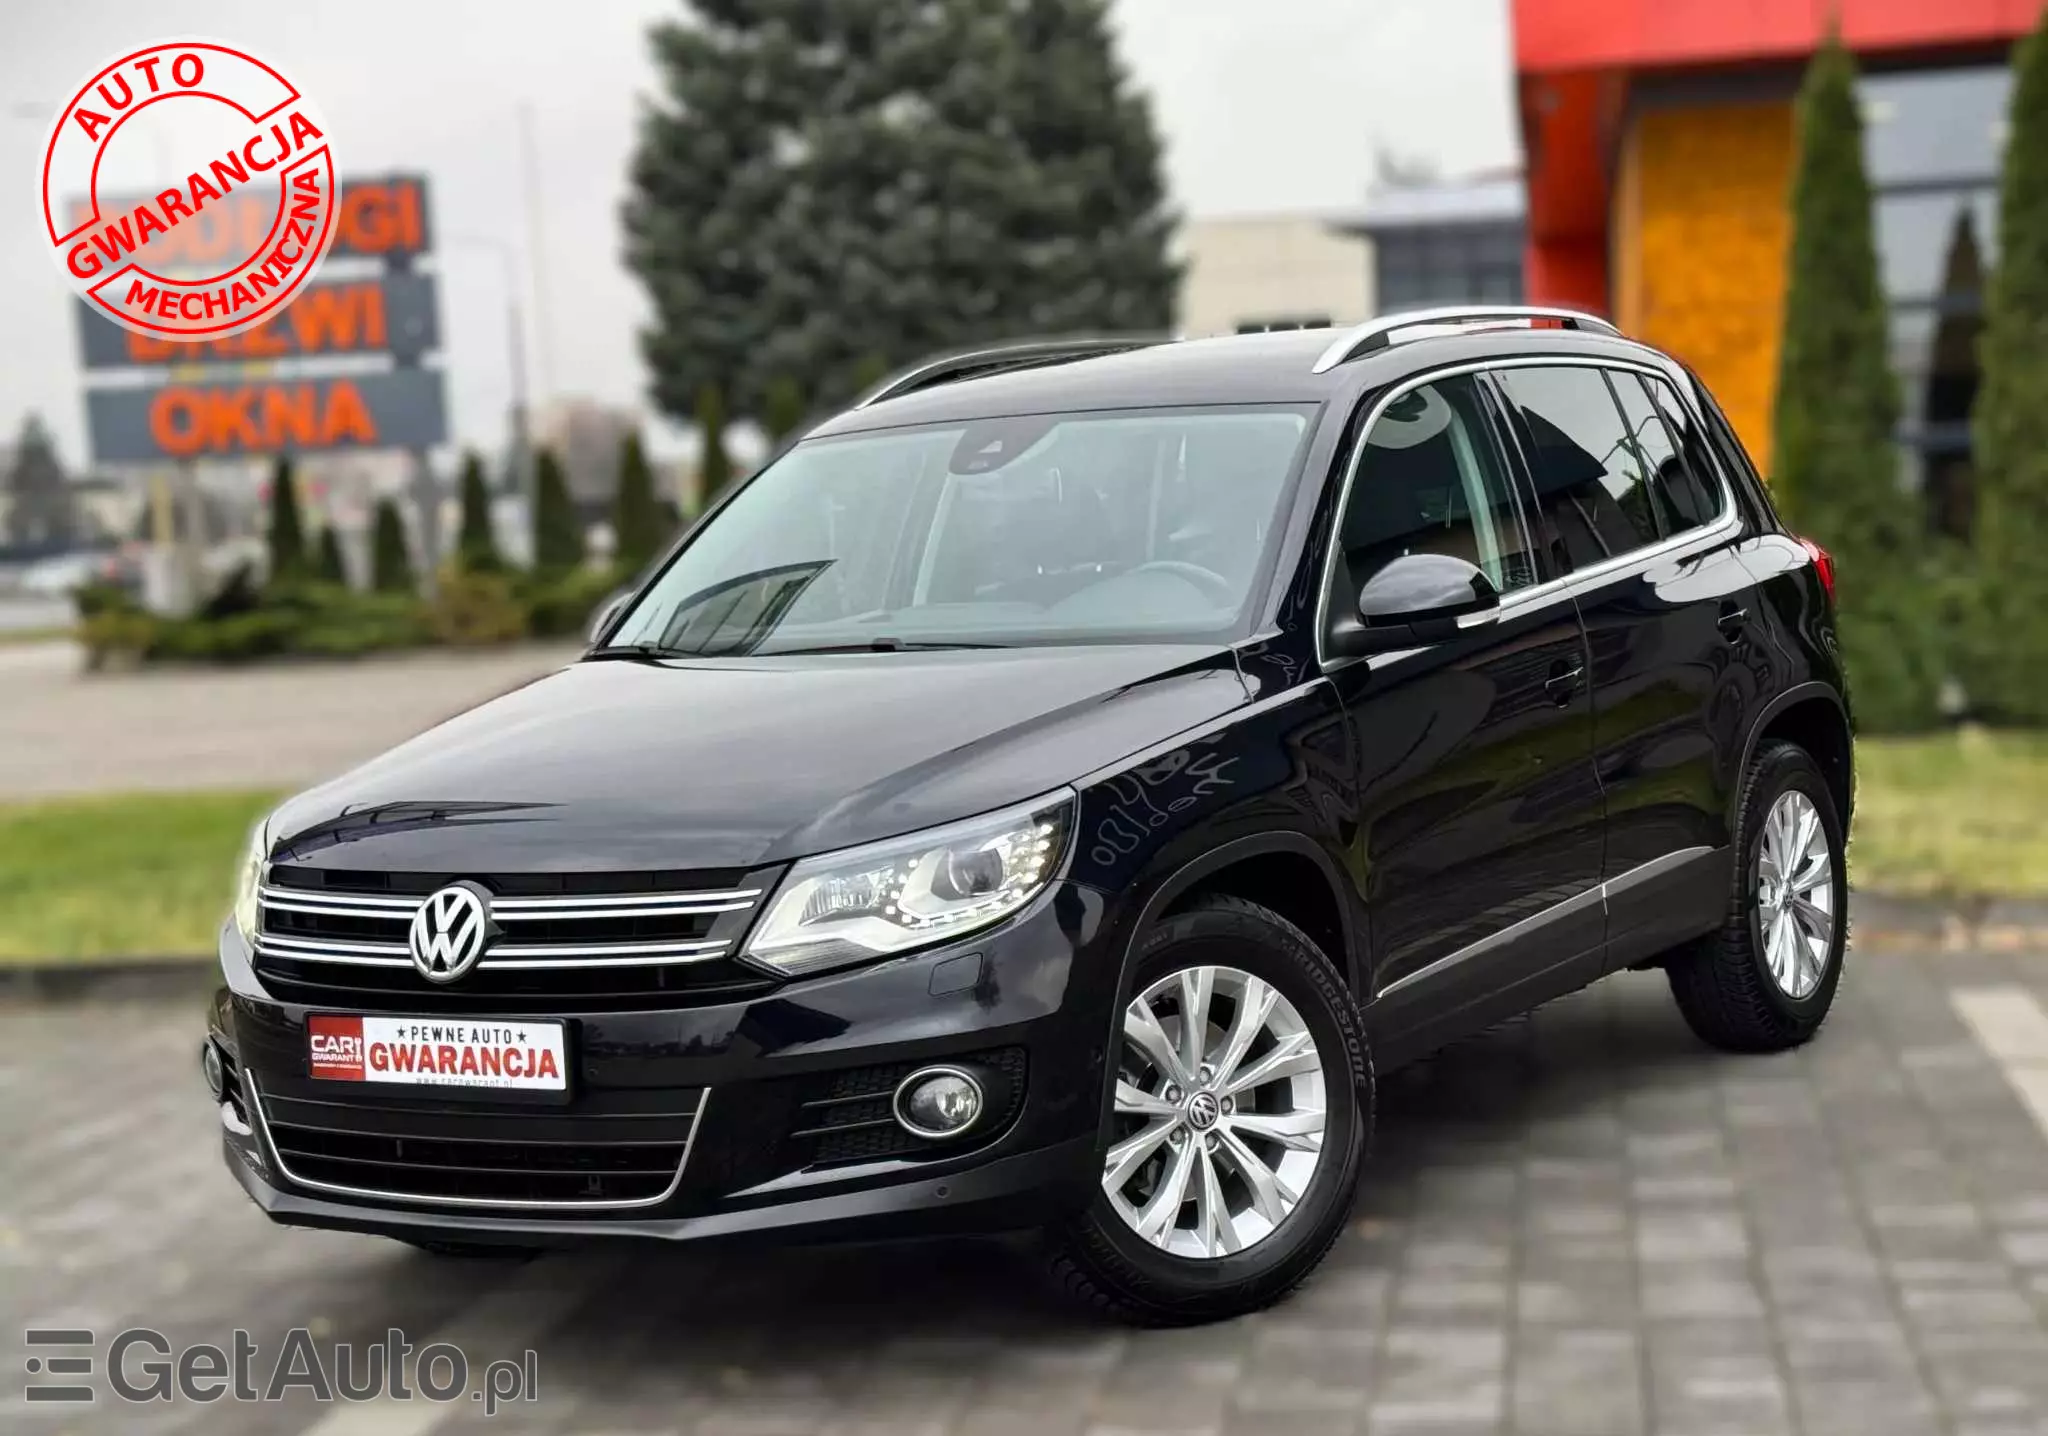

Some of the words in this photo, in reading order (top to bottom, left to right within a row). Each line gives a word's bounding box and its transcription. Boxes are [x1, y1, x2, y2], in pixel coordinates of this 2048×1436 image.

[148, 378, 378, 455] OKNA
[411, 1025, 465, 1043] PEWNE
[471, 1028, 513, 1044] AUTO
[369, 1042, 560, 1079] GWARANCJA
